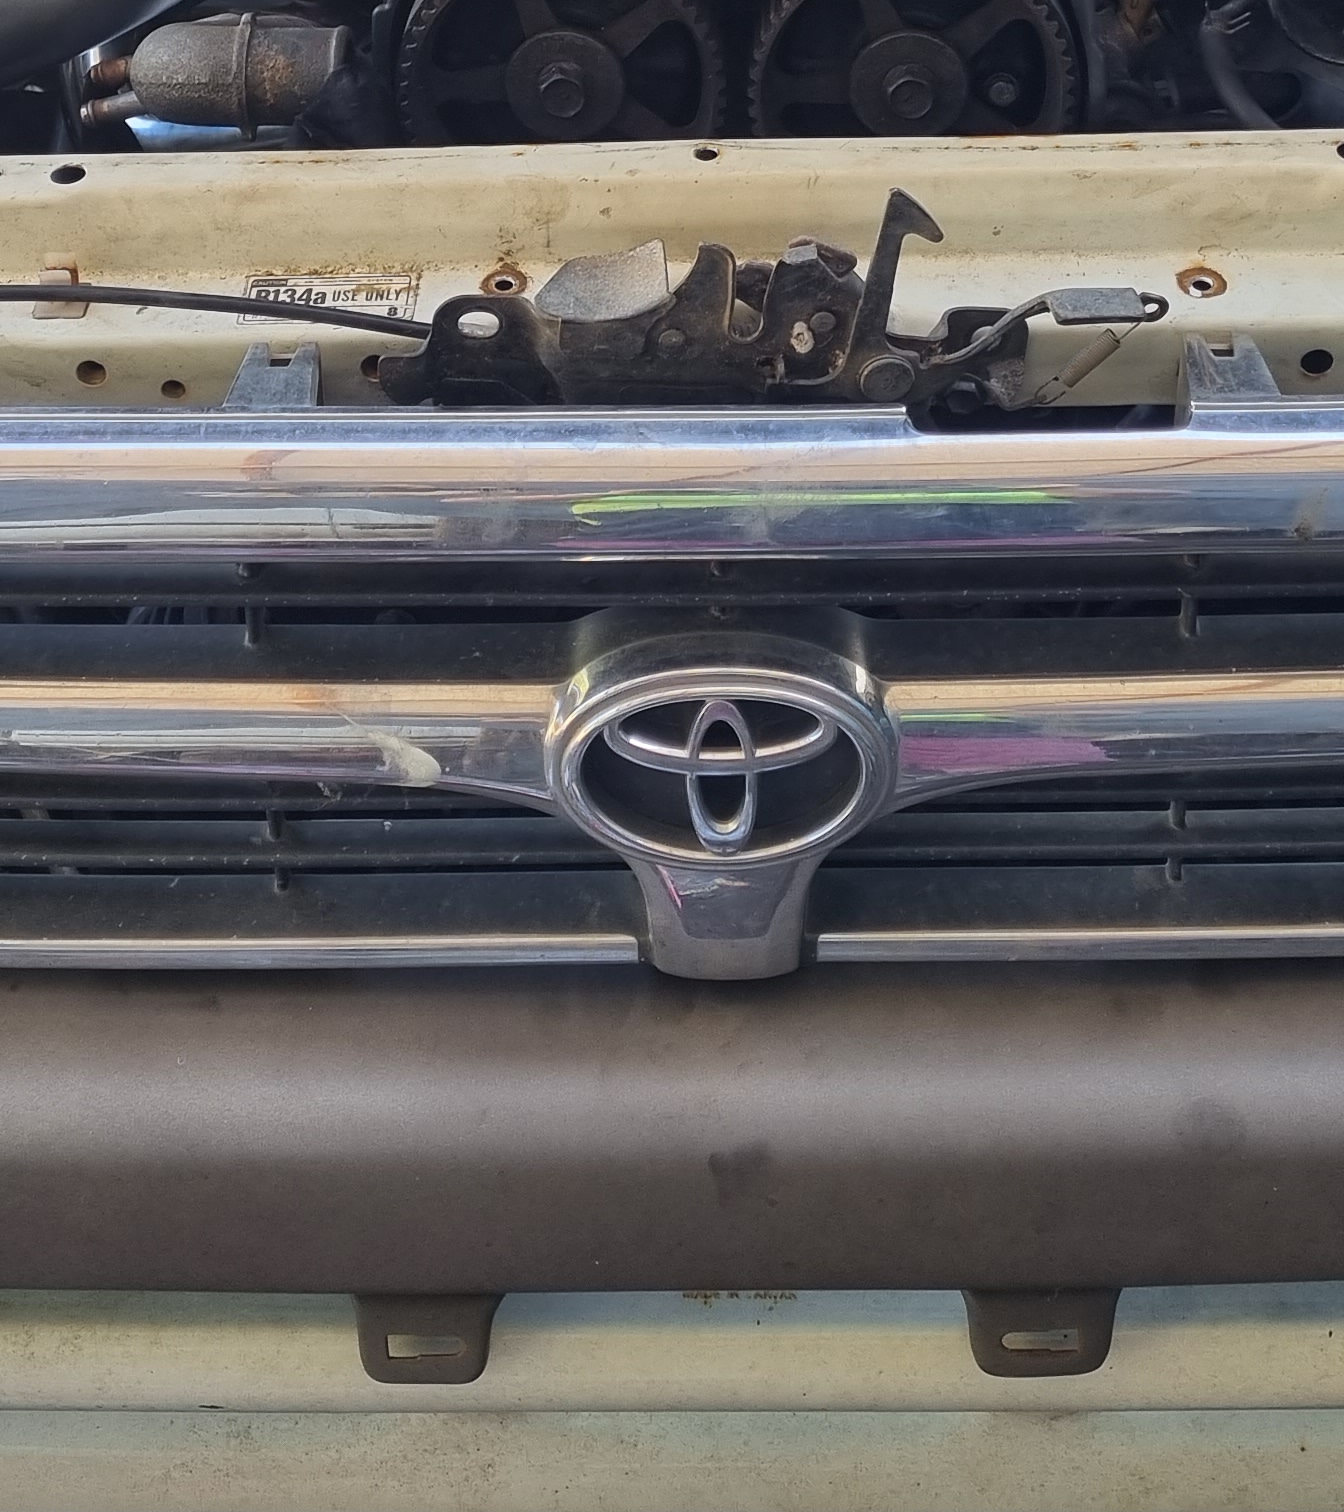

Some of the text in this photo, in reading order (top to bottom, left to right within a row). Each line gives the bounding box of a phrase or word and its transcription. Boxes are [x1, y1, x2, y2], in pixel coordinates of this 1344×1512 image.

[256, 288, 403, 305] R134a USE ONLY
